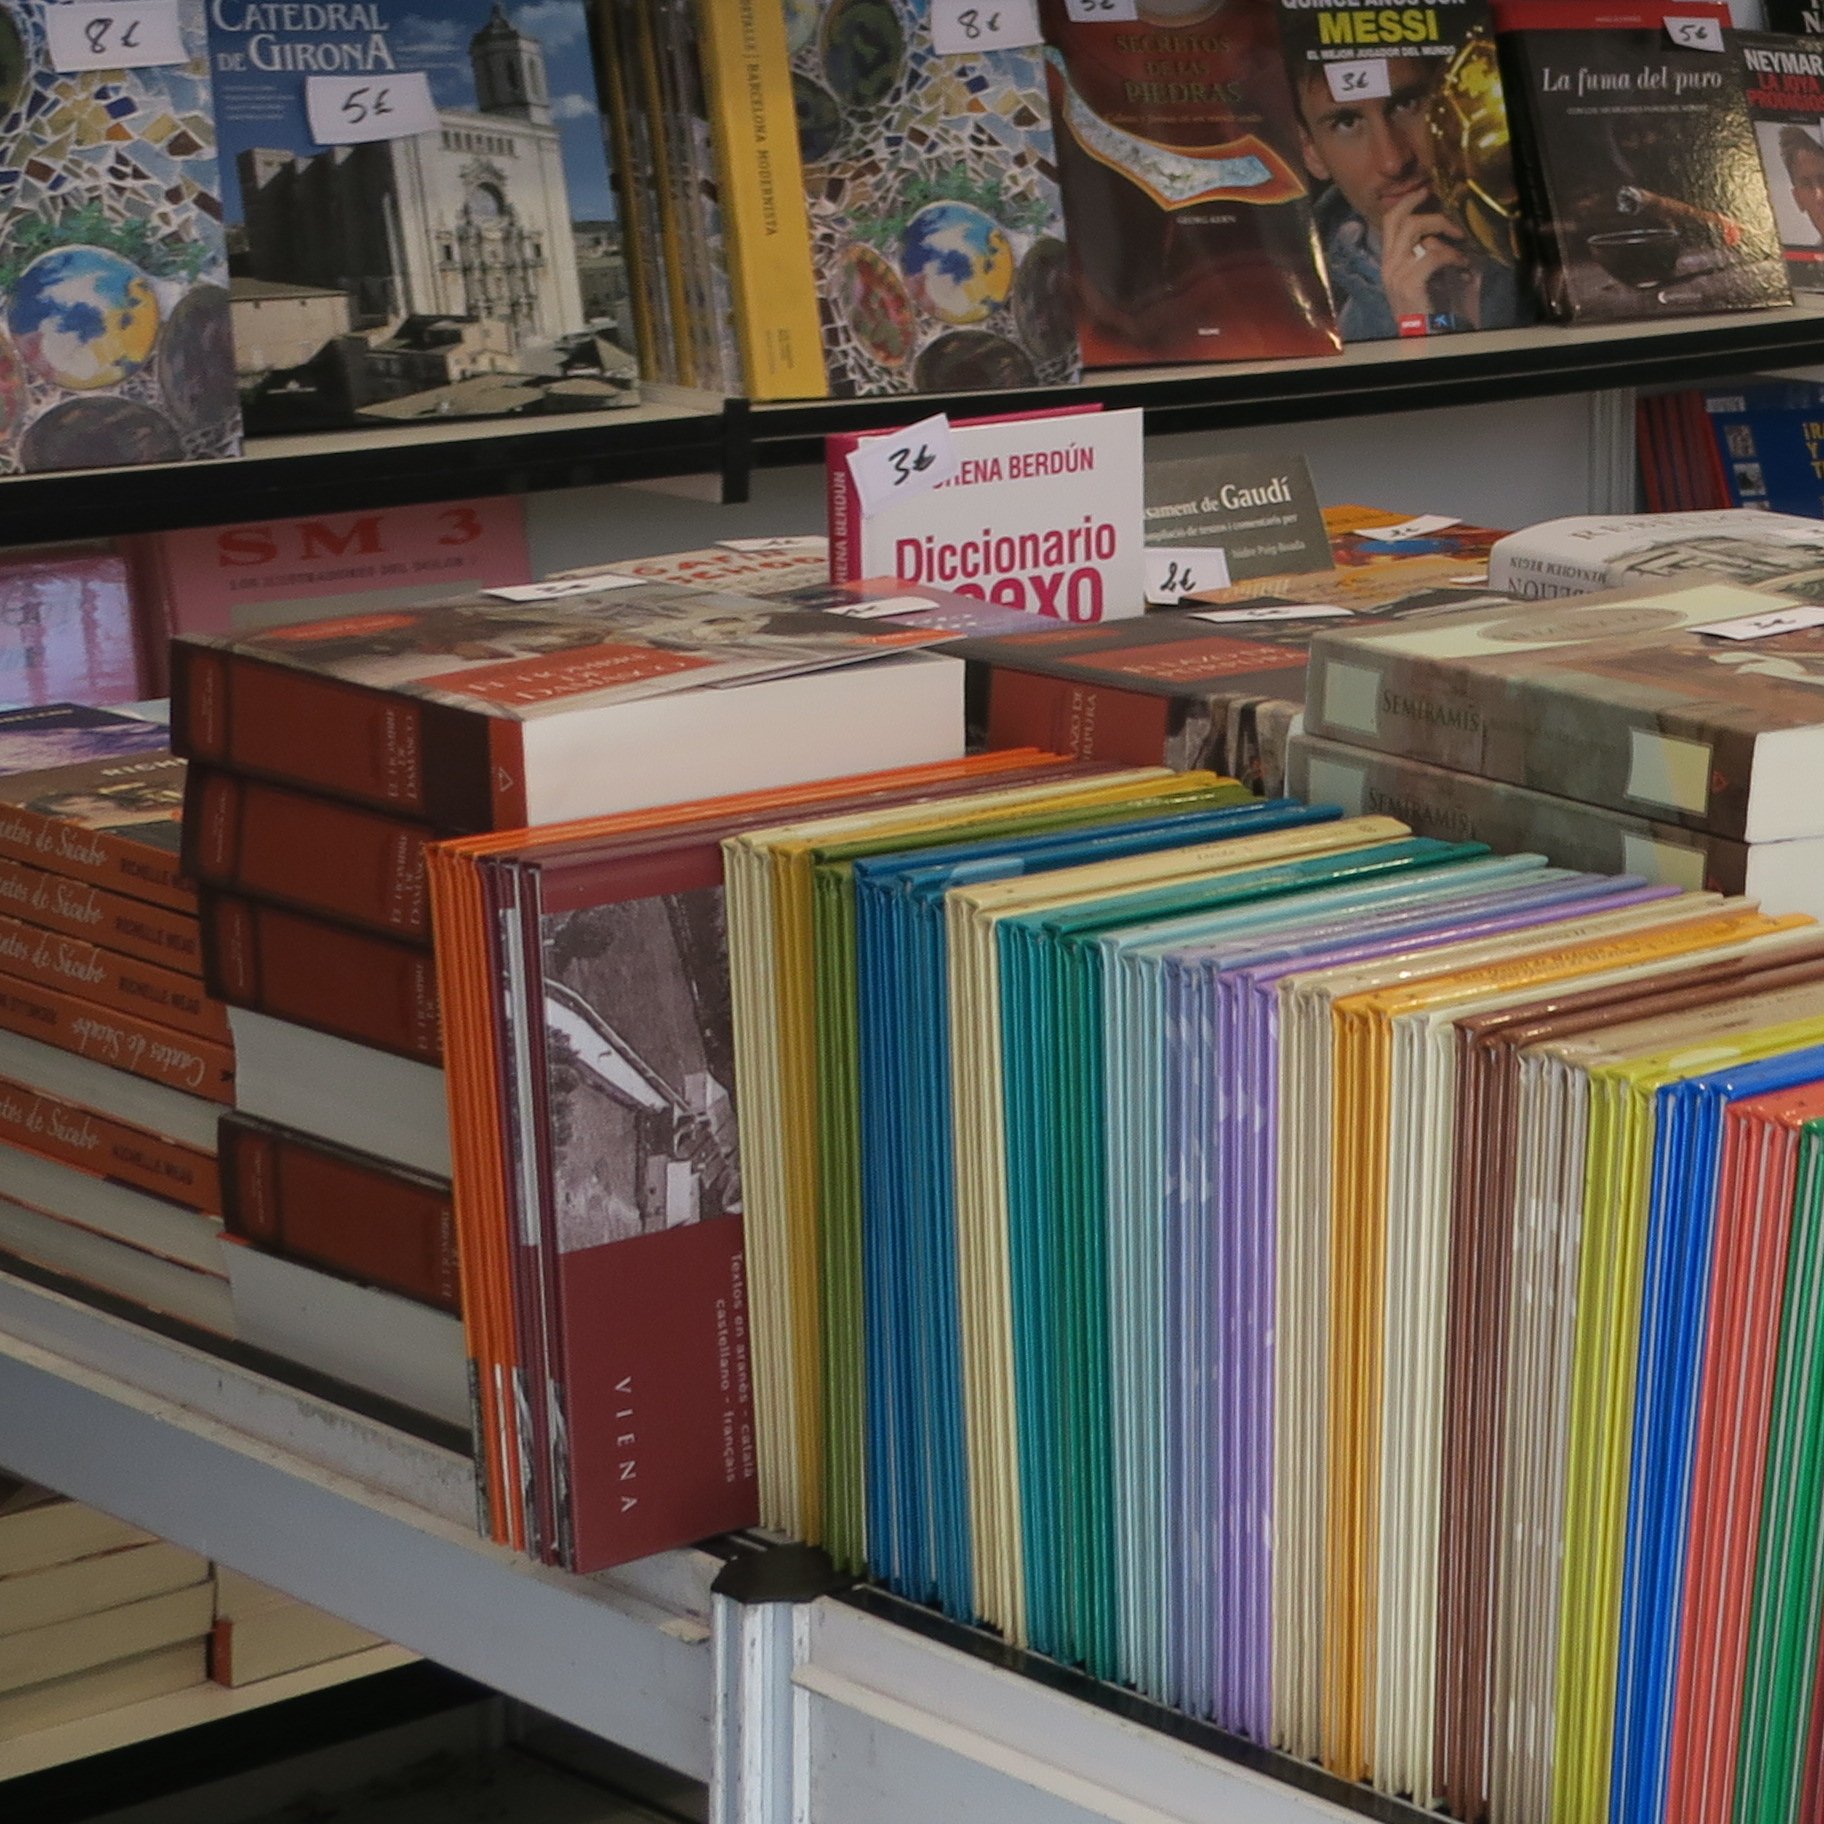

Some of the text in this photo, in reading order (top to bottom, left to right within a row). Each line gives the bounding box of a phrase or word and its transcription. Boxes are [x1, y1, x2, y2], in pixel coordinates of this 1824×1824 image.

[82, 15, 143, 55] 8€
[1318, 7, 1440, 44] MESSI
[217, 32, 397, 73] DE GIRONA
[1541, 65, 1723, 97] La fuma del puro
[340, 88, 395, 126] 5€
[889, 445, 936, 487] 3€
[1008, 444, 1095, 480] BERDÚN
[1219, 475, 1293, 513] Gaudí
[437, 507, 486, 547] 3
[895, 516, 1118, 583] Diccionario
[613, 1374, 638, 1514] VIENA
